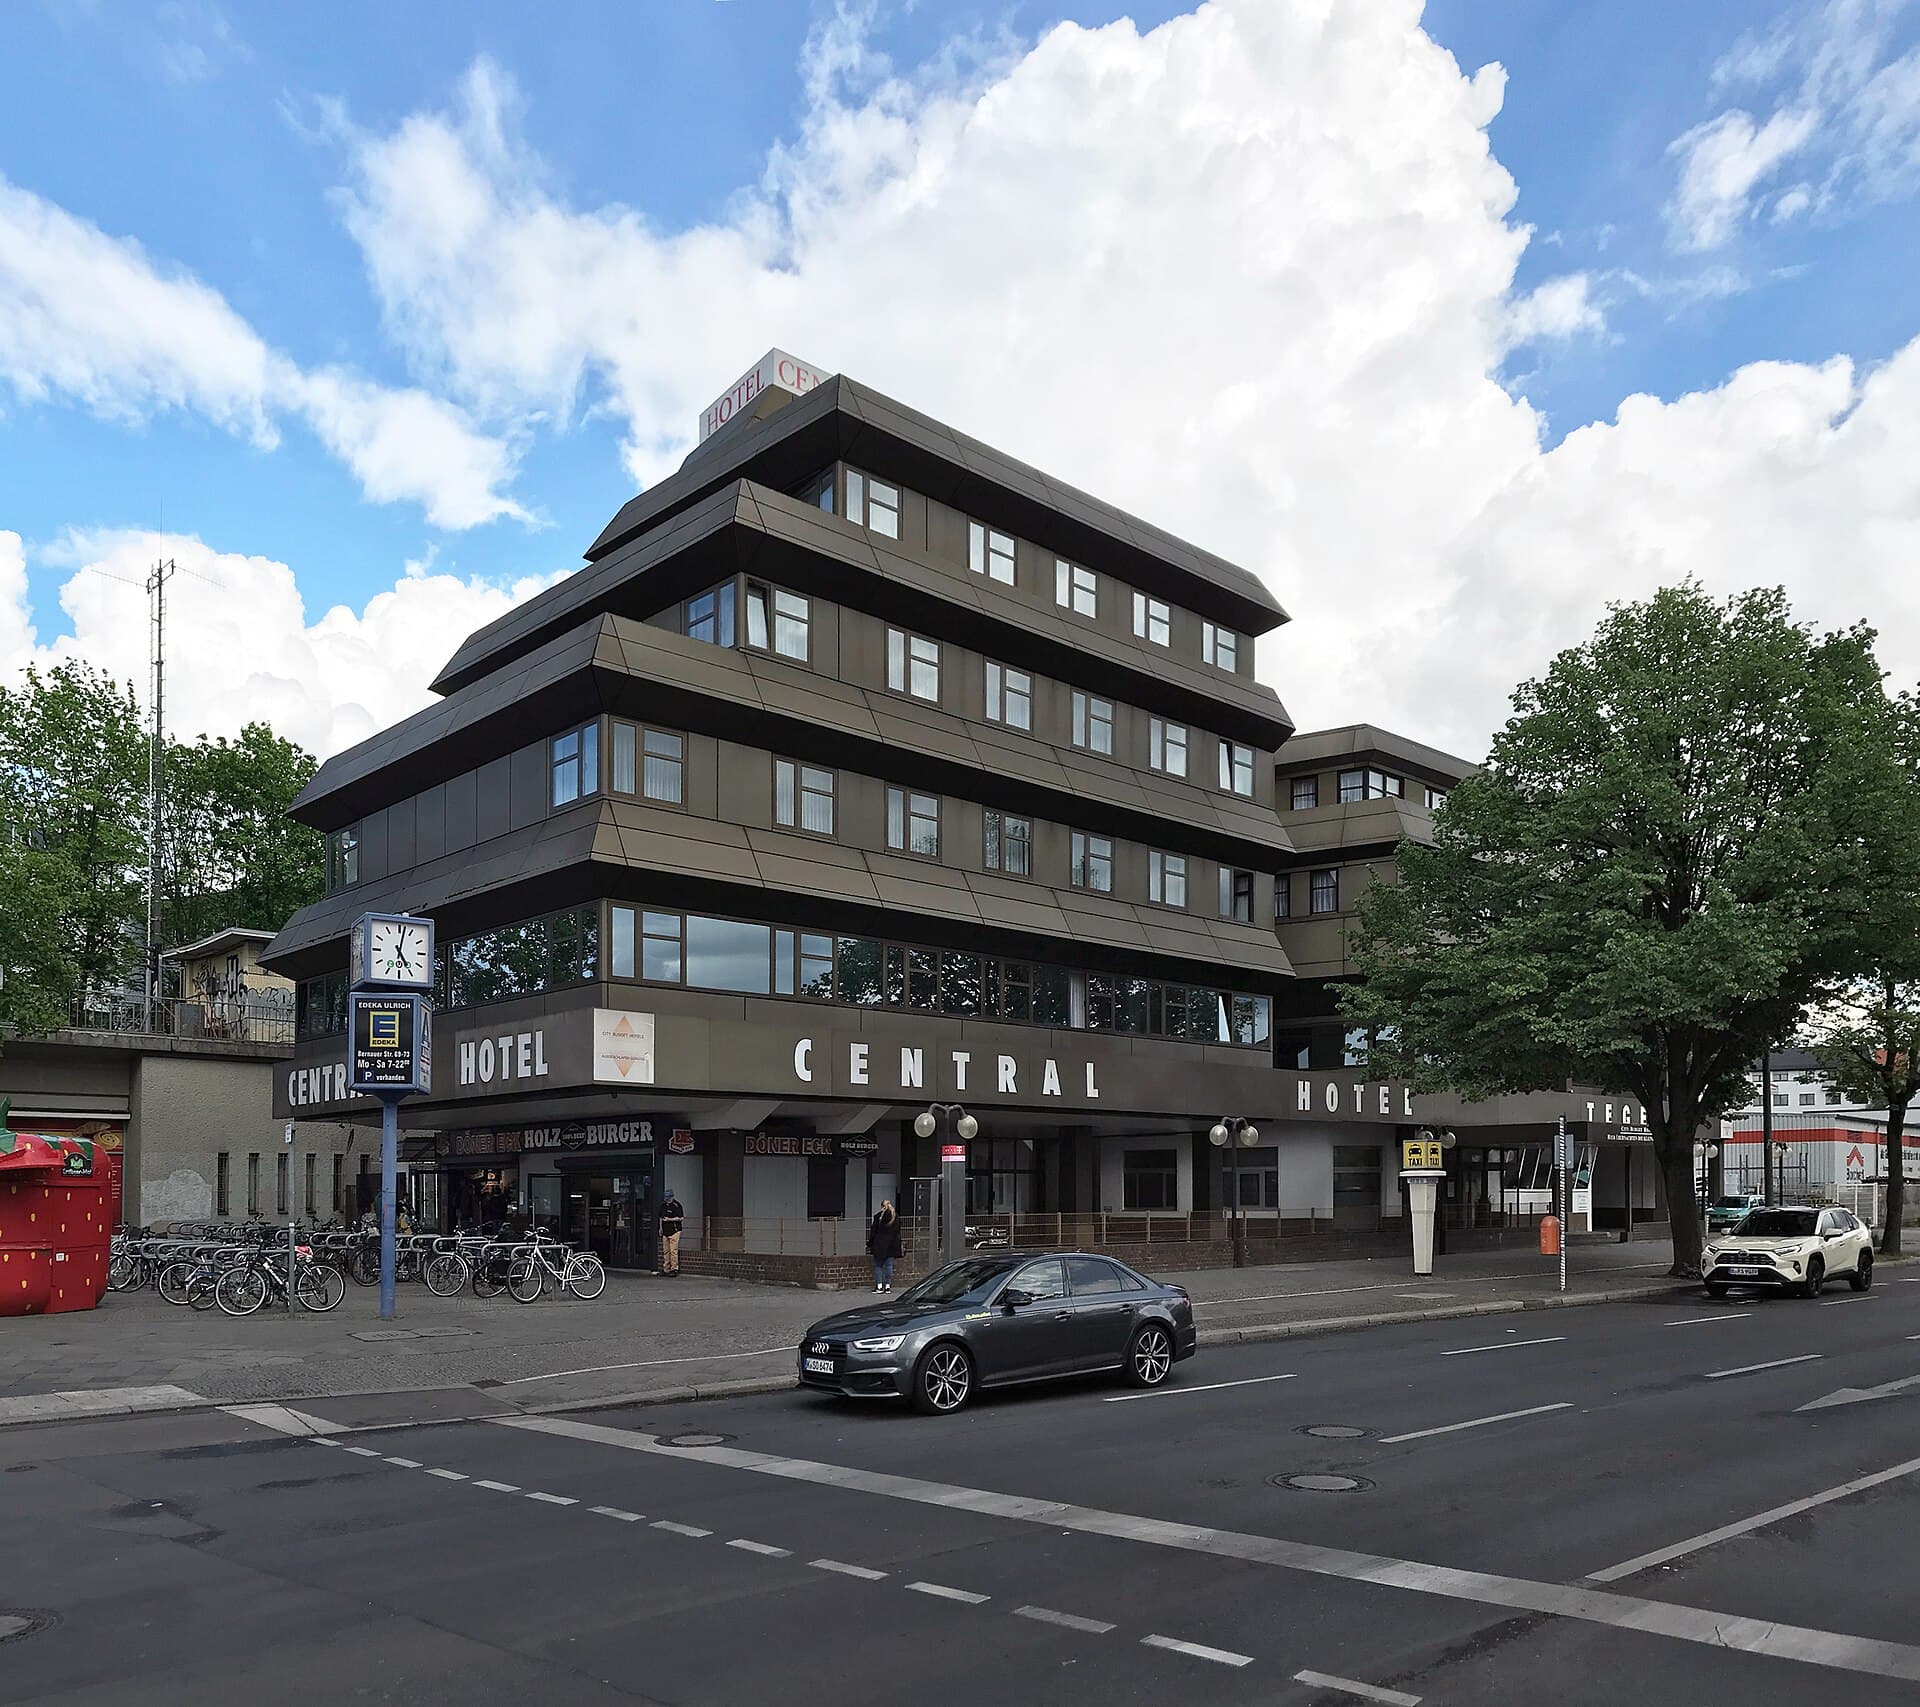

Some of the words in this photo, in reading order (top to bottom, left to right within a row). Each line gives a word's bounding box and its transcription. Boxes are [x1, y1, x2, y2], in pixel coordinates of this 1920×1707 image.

[706, 368, 765, 436] HOTEL
[357, 1050, 382, 1058] Bernauer
[384, 1050, 394, 1058] Str.
[357, 1060, 370, 1069] Mo
[376, 1060, 386, 1069] Sa
[460, 1031, 549, 1085] HOTEL
[365, 1071, 373, 1080] P
[376, 1073, 405, 1081] vorhanden
[794, 1038, 1099, 1098] CENTRAL
[288, 1063, 374, 1106] CENTR
[1297, 1080, 1413, 1116] HOTEL
[1586, 1102, 1648, 1125] TEGE
[524, 1128, 561, 1149] HOLZ
[587, 1121, 653, 1145] BURGER
[745, 1132, 799, 1154] DÖNER
[802, 1137, 833, 1155] ECK
[1408, 1157, 1423, 1166] TAXI
[1429, 1157, 1440, 1166] TAXI
